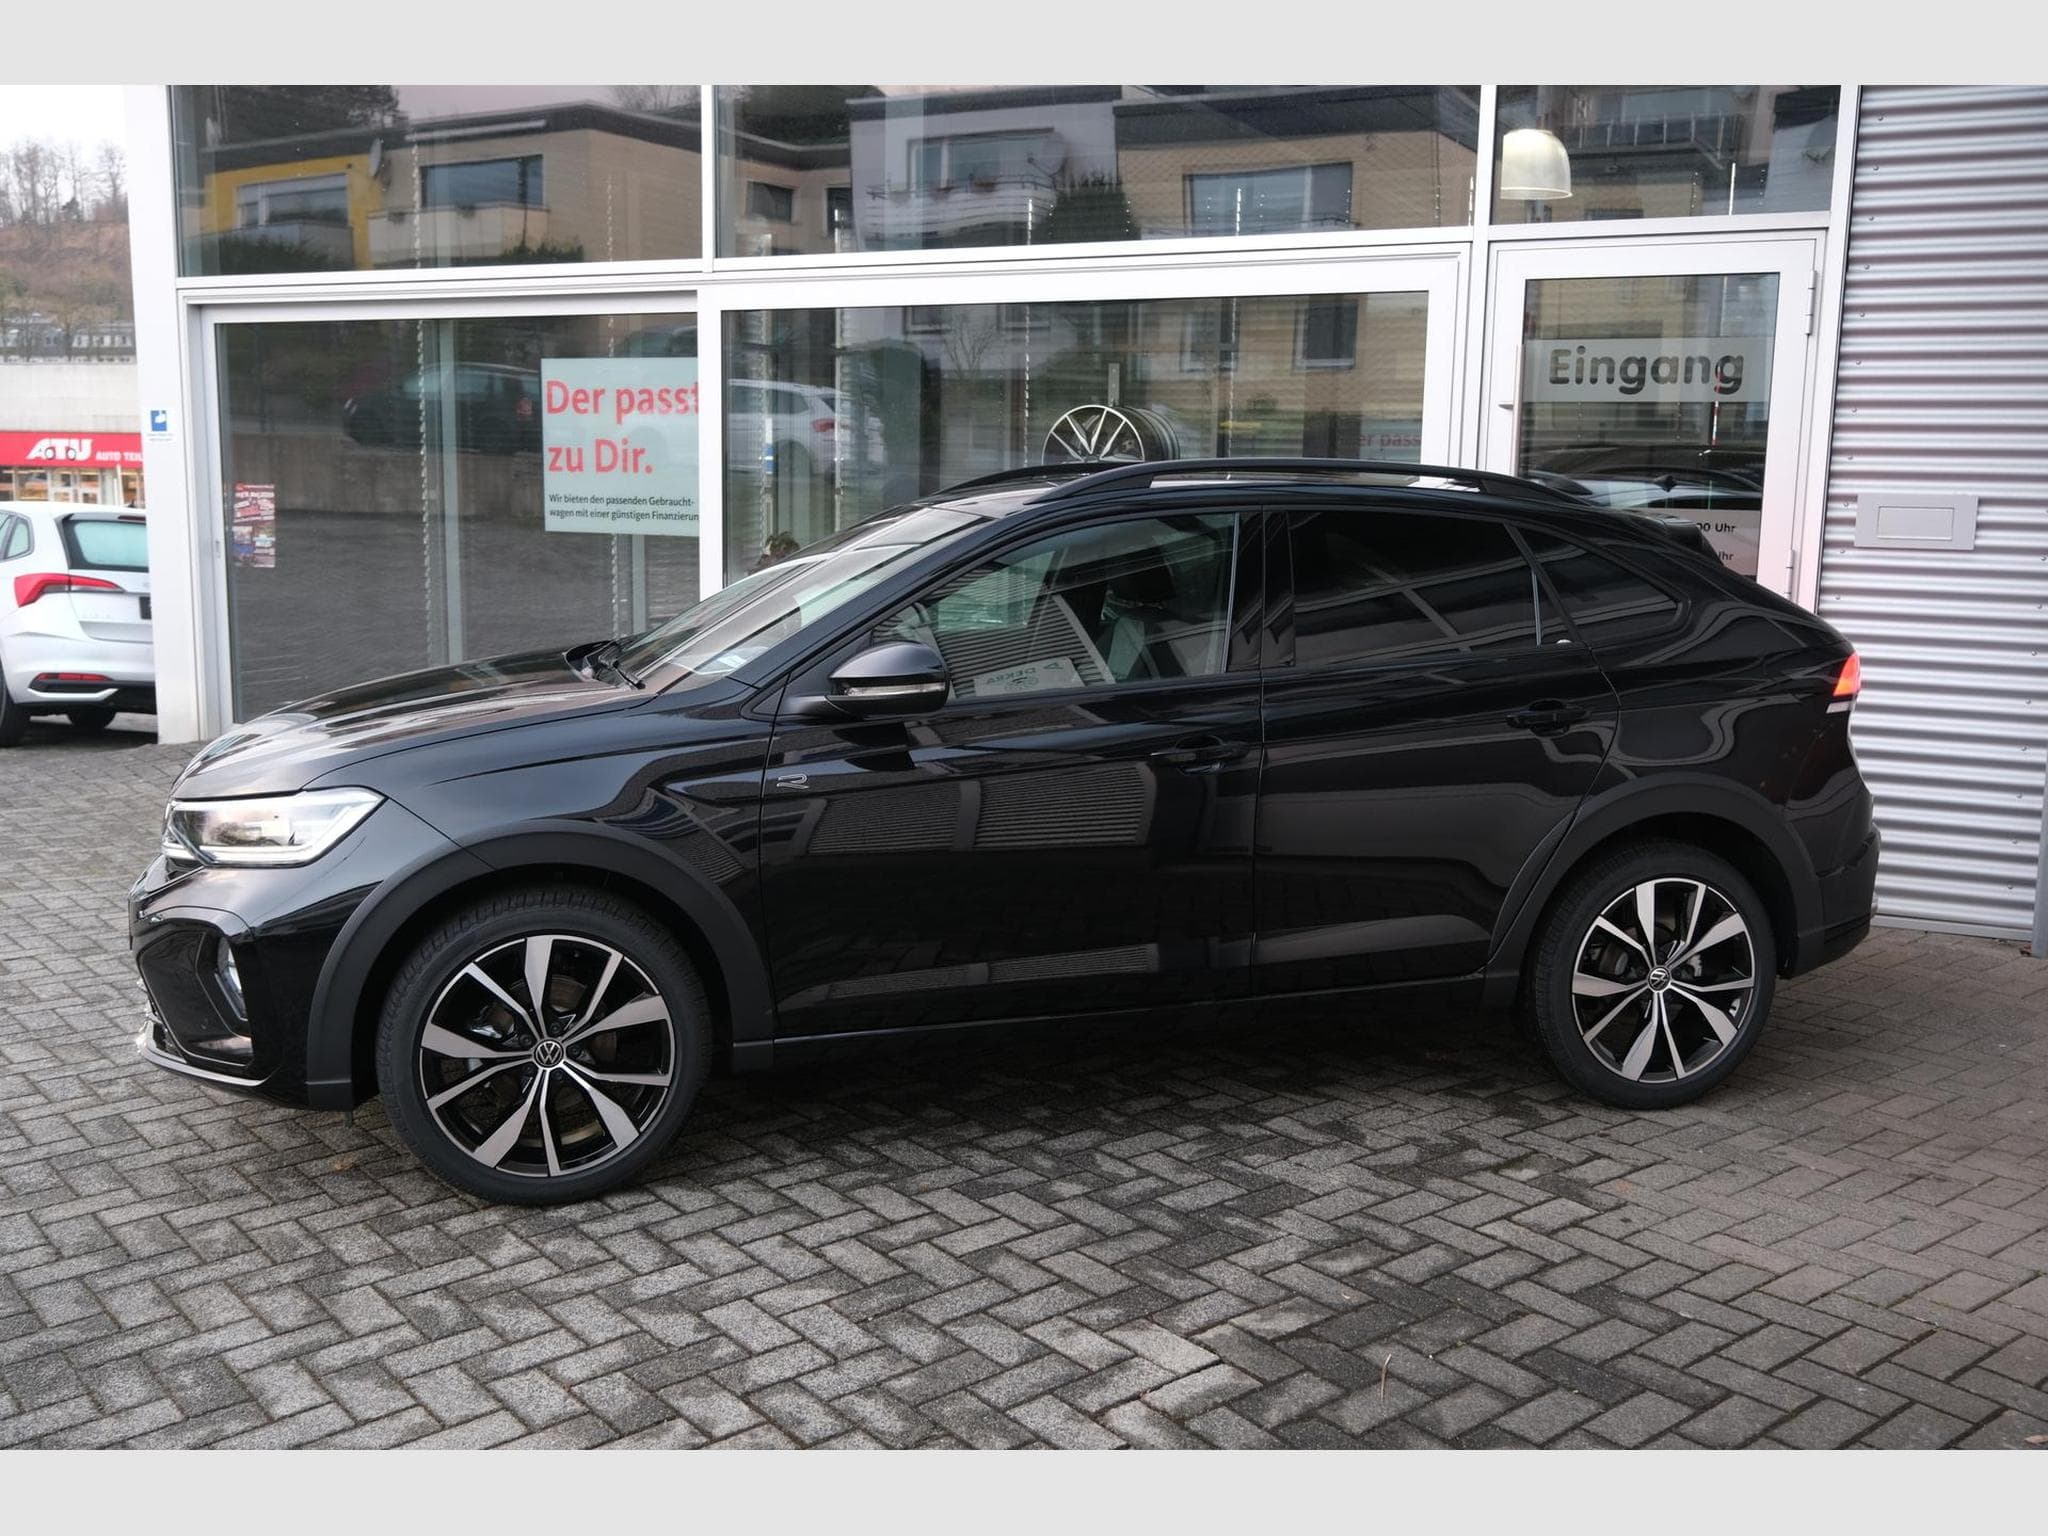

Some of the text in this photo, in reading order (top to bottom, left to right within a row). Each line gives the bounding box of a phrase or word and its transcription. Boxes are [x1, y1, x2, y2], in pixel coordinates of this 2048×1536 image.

[1549, 345, 1744, 395] Eingang
[546, 380, 605, 415] Der
[25, 438, 93, 461] ATU
[95, 451, 121, 462] AUTO
[547, 437, 654, 474] zu Dir.
[549, 494, 694, 507] Wir bieten den passenden Gebraucht-
[549, 509, 574, 519] wagen
[575, 508, 588, 518] mit
[590, 509, 610, 519] einer
[611, 510, 650, 521] günstigen
[1715, 522, 1736, 532] Uhr
